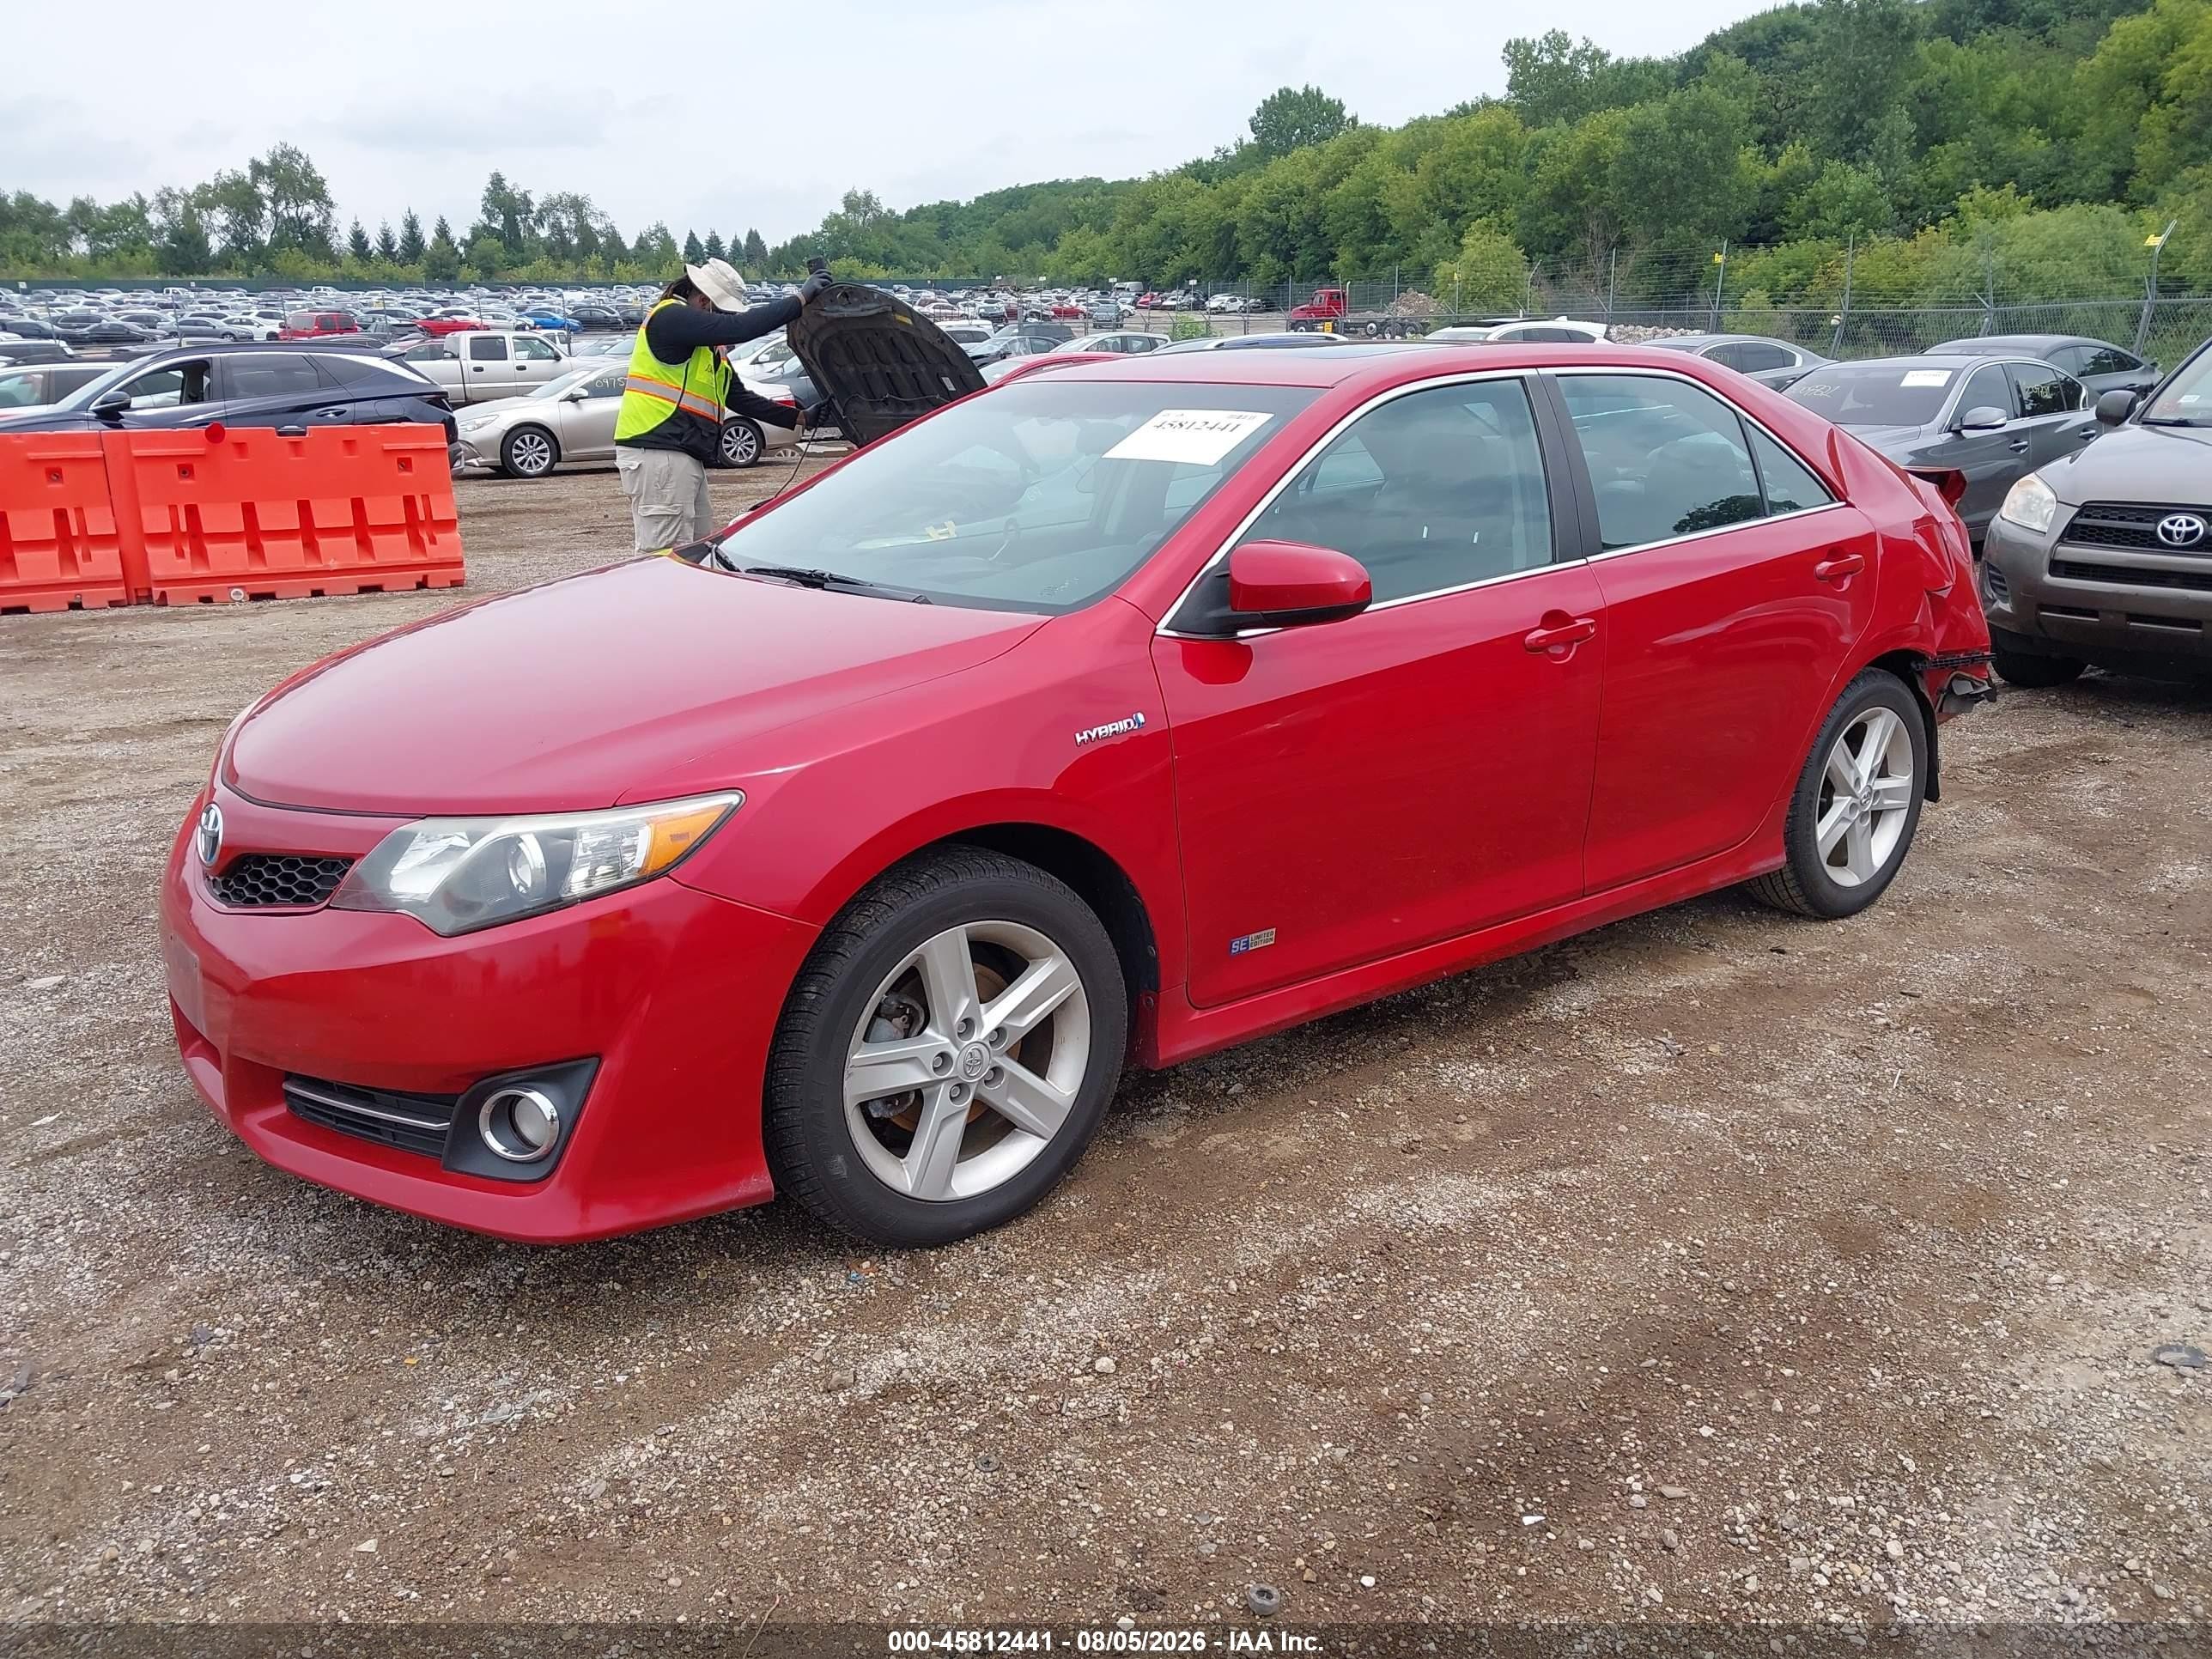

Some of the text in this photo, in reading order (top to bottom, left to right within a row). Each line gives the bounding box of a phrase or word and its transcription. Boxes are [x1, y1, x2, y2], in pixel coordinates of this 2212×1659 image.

[1074, 717, 1135, 747] HYBRID
[1250, 930, 1274, 942] LIMITED
[1250, 936, 1273, 948] EDITION
[1231, 937, 1249, 954] SE
